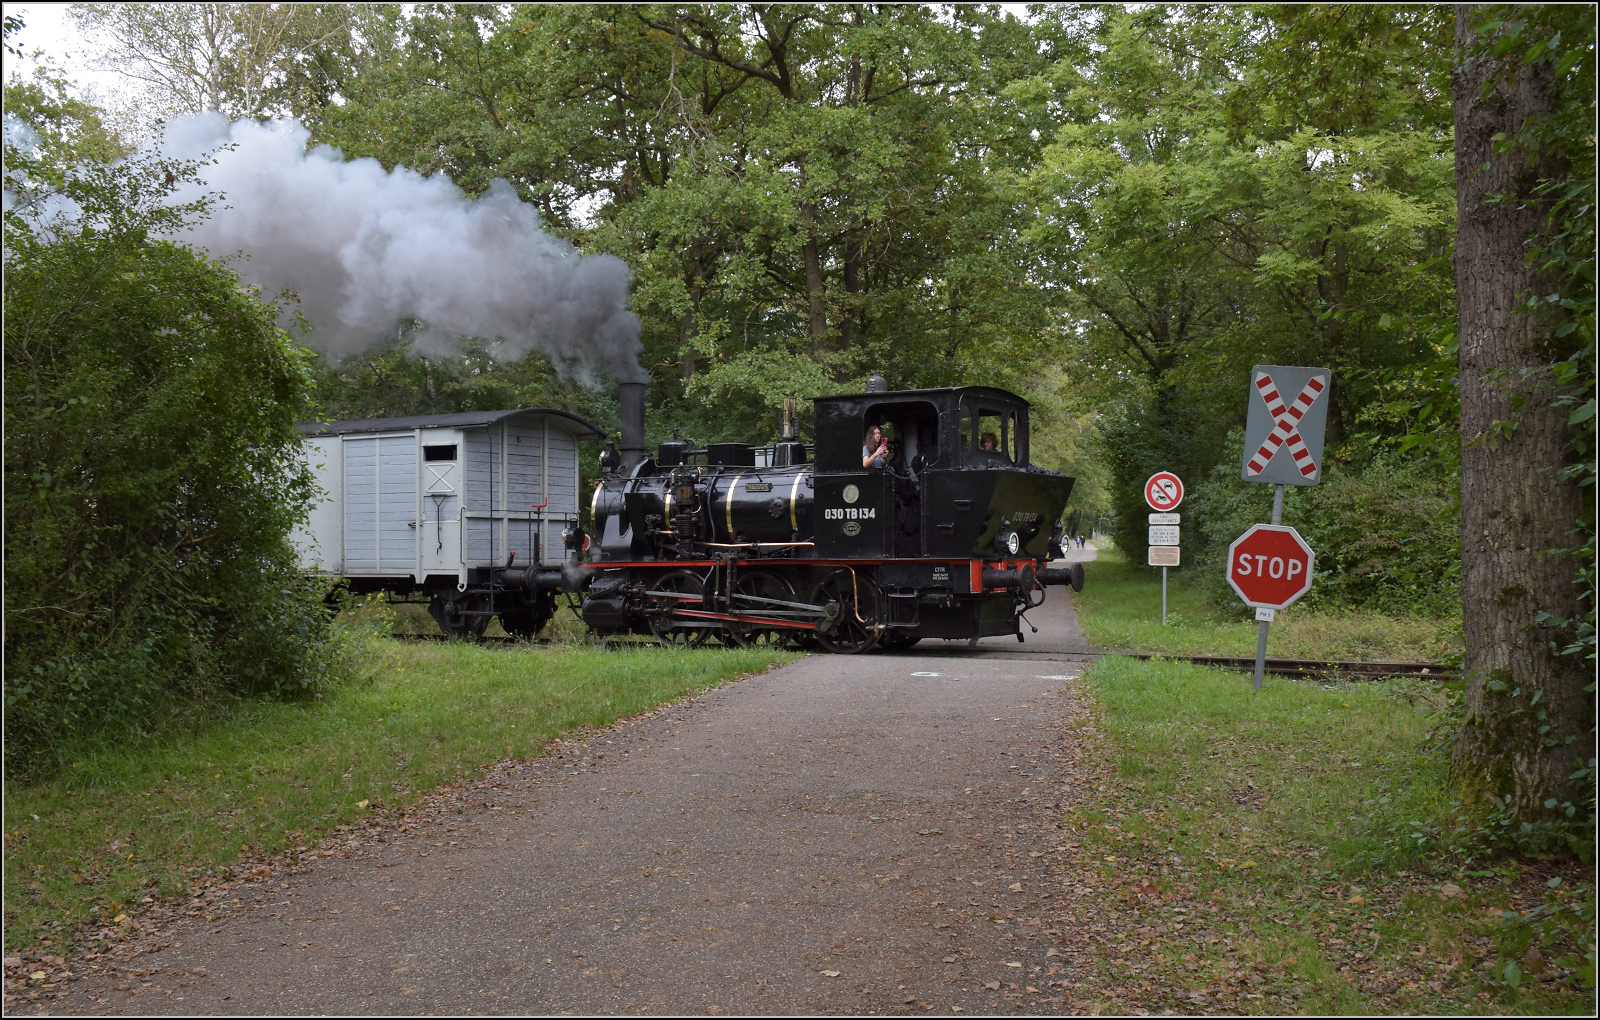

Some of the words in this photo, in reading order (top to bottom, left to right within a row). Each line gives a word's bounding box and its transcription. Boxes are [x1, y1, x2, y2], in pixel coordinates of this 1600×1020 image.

[824, 508, 844, 520] 030
[845, 508, 858, 519] TB
[859, 508, 876, 519] 134
[1012, 512, 1024, 522] 030
[1023, 512, 1030, 522] TB
[1029, 512, 1038, 522] 134
[1236, 553, 1302, 580] STOP
